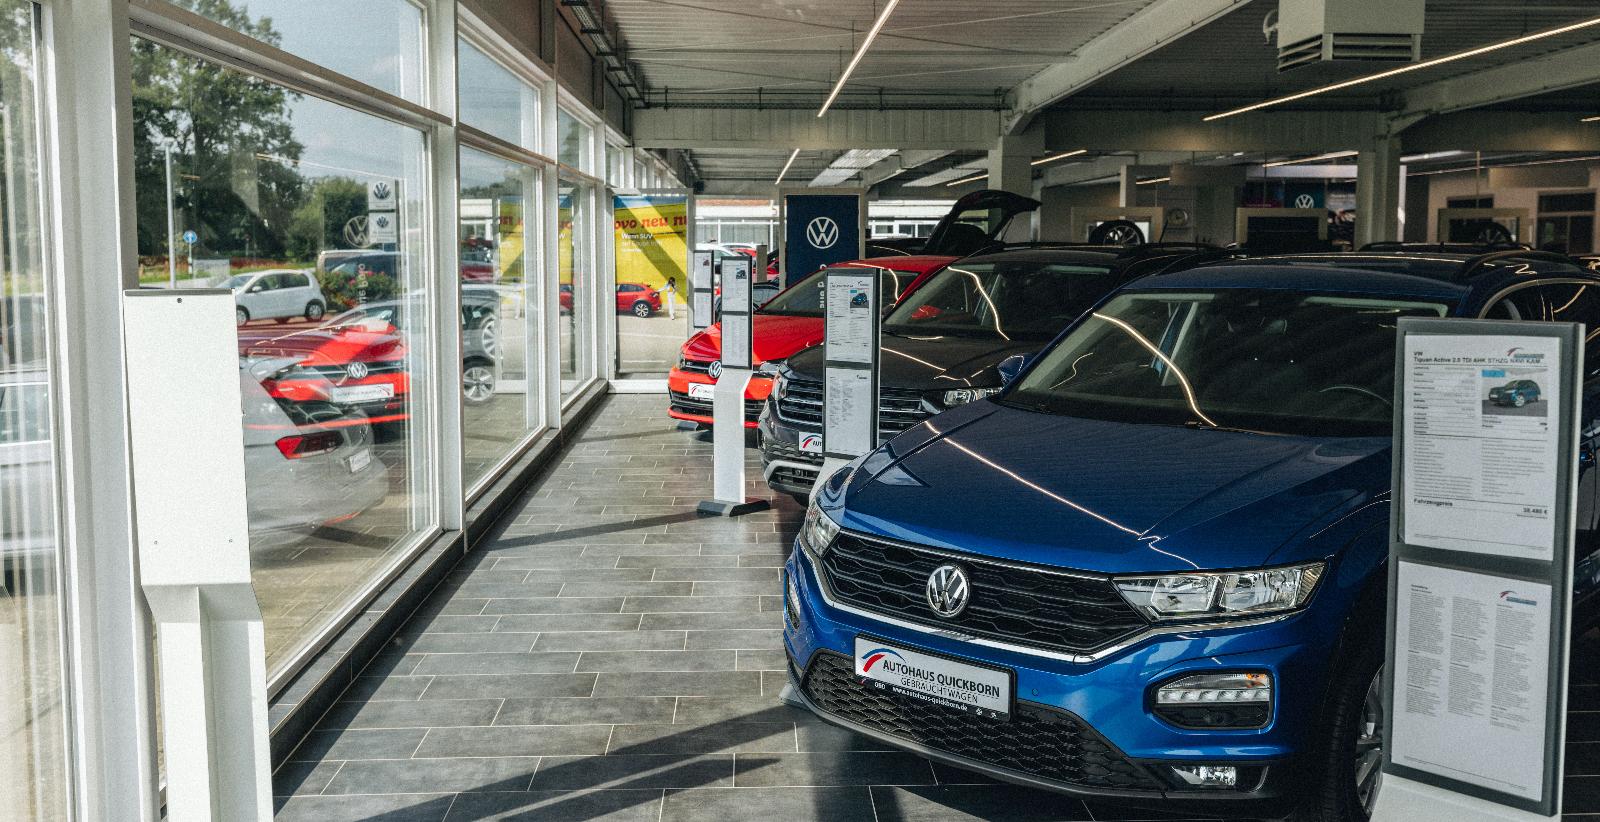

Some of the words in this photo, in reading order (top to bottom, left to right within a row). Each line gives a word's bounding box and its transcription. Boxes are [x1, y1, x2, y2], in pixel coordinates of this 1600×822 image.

[641, 217, 668, 228] neu
[1413, 498, 1453, 507] Fahrzeugpreis
[882, 659, 935, 682] AUTOHAUS
[937, 673, 1001, 698] QUICKBORN
[900, 677, 978, 704] GEBRAUCHTWAGEN
